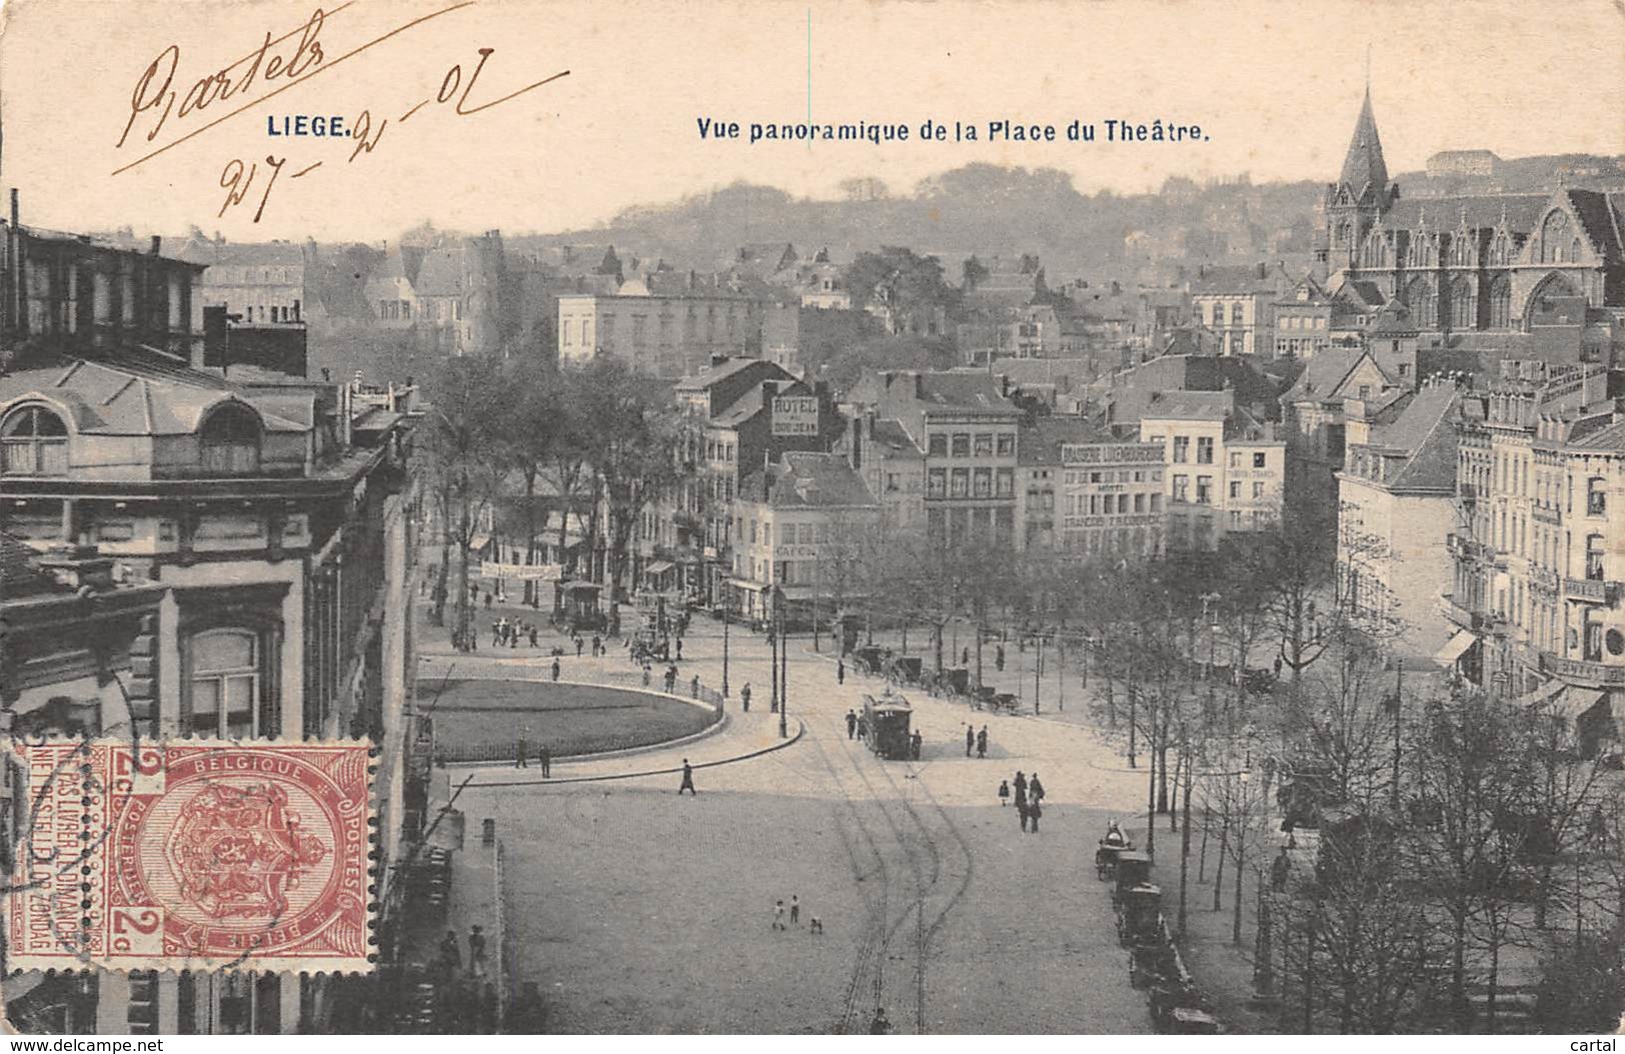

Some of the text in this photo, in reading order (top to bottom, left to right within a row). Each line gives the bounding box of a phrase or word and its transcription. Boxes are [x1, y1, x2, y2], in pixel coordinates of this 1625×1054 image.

[194, 756, 303, 780] BELGIQUE
[57, 772, 80, 797] PAS
[57, 801, 79, 848] LIVRER
[56, 853, 79, 869] LE
[345, 814, 360, 890] POSTES
